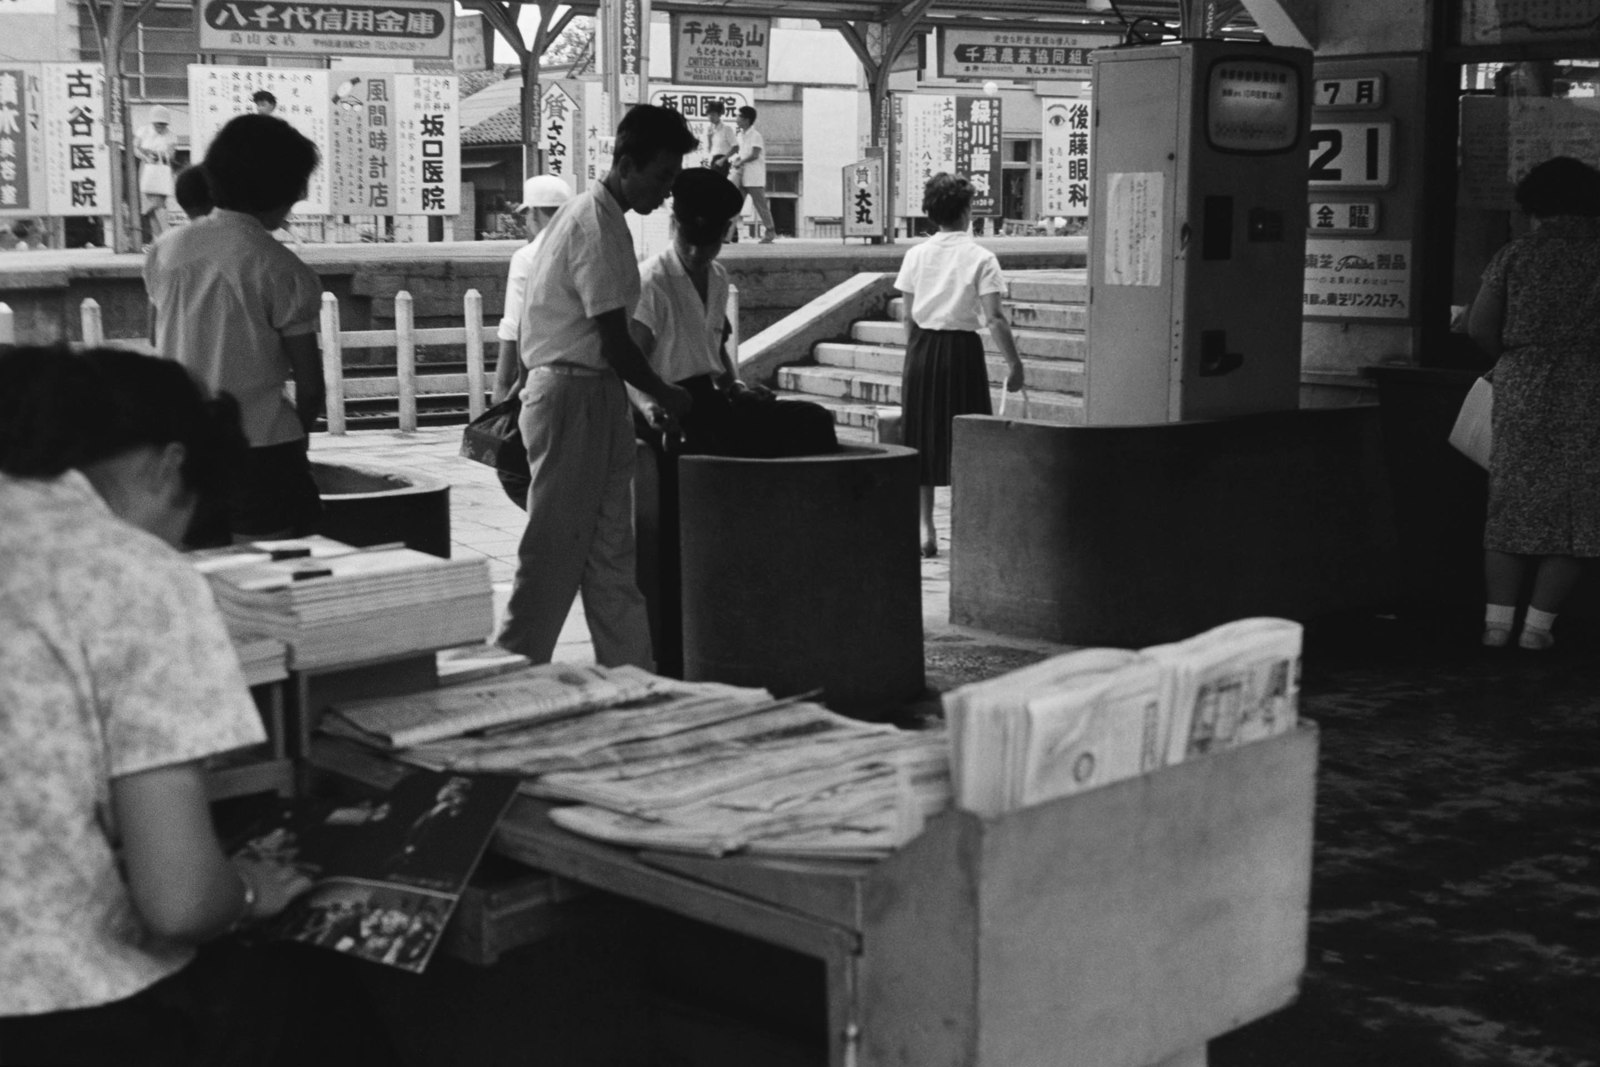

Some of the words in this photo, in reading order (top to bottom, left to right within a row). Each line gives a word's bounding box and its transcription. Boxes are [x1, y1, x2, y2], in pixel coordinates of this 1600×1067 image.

[214, 3, 436, 35] 八千代信用金庫
[543, 94, 569, 121] 質
[1323, 80, 1375, 105] 7月
[66, 69, 98, 207] 古谷医院
[366, 78, 389, 208] 風間時計店
[942, 98, 954, 162] 土地測量
[420, 113, 446, 211] 坂口医院
[1068, 104, 1089, 208] 後藤眼科
[1309, 127, 1380, 182] 21
[854, 189, 874, 226] 大丸
[1316, 204, 1370, 229] 金曜
[1305, 253, 1334, 270] 東芝
[1377, 253, 1407, 271] 製品
